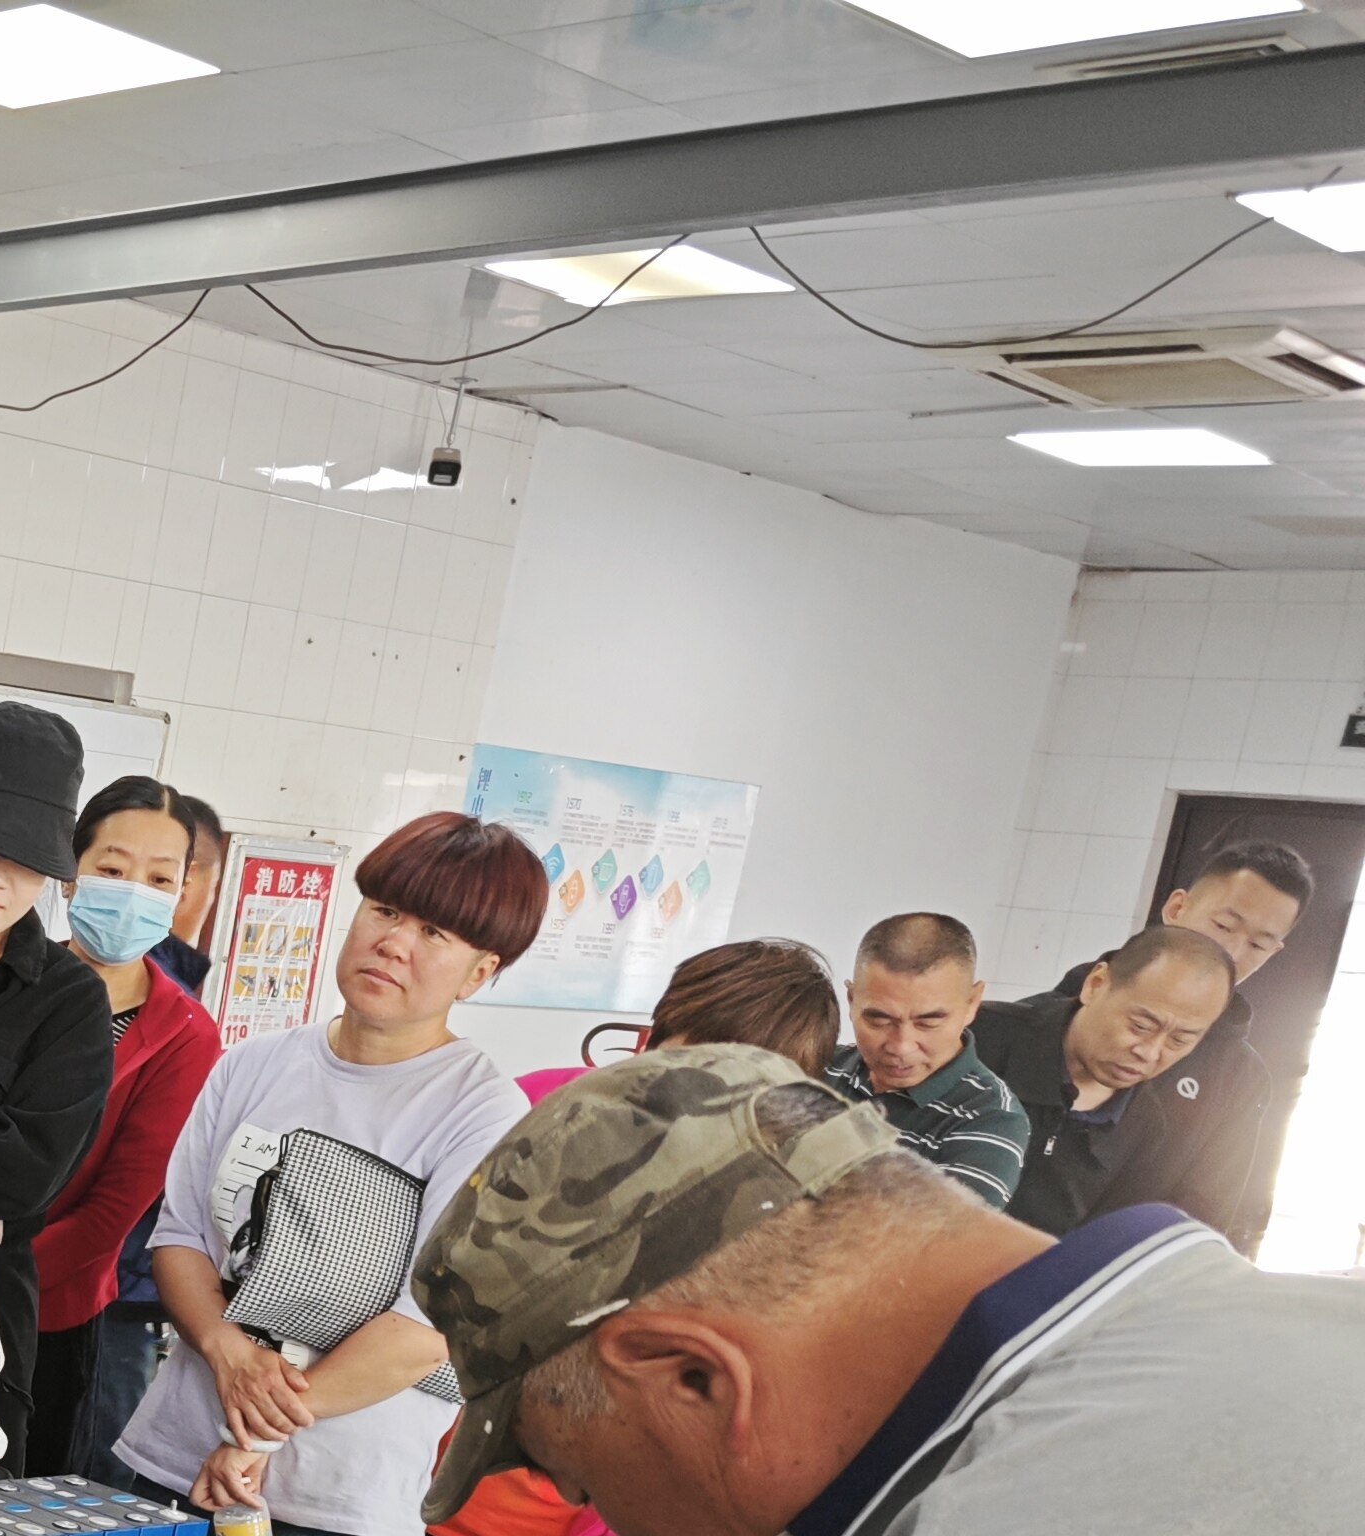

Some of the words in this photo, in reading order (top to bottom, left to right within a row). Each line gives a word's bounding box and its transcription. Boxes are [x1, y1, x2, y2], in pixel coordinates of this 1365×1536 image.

[254, 866, 323, 896] 消防栓
[225, 1024, 248, 1045] 119
[240, 1135, 252, 1149] I
